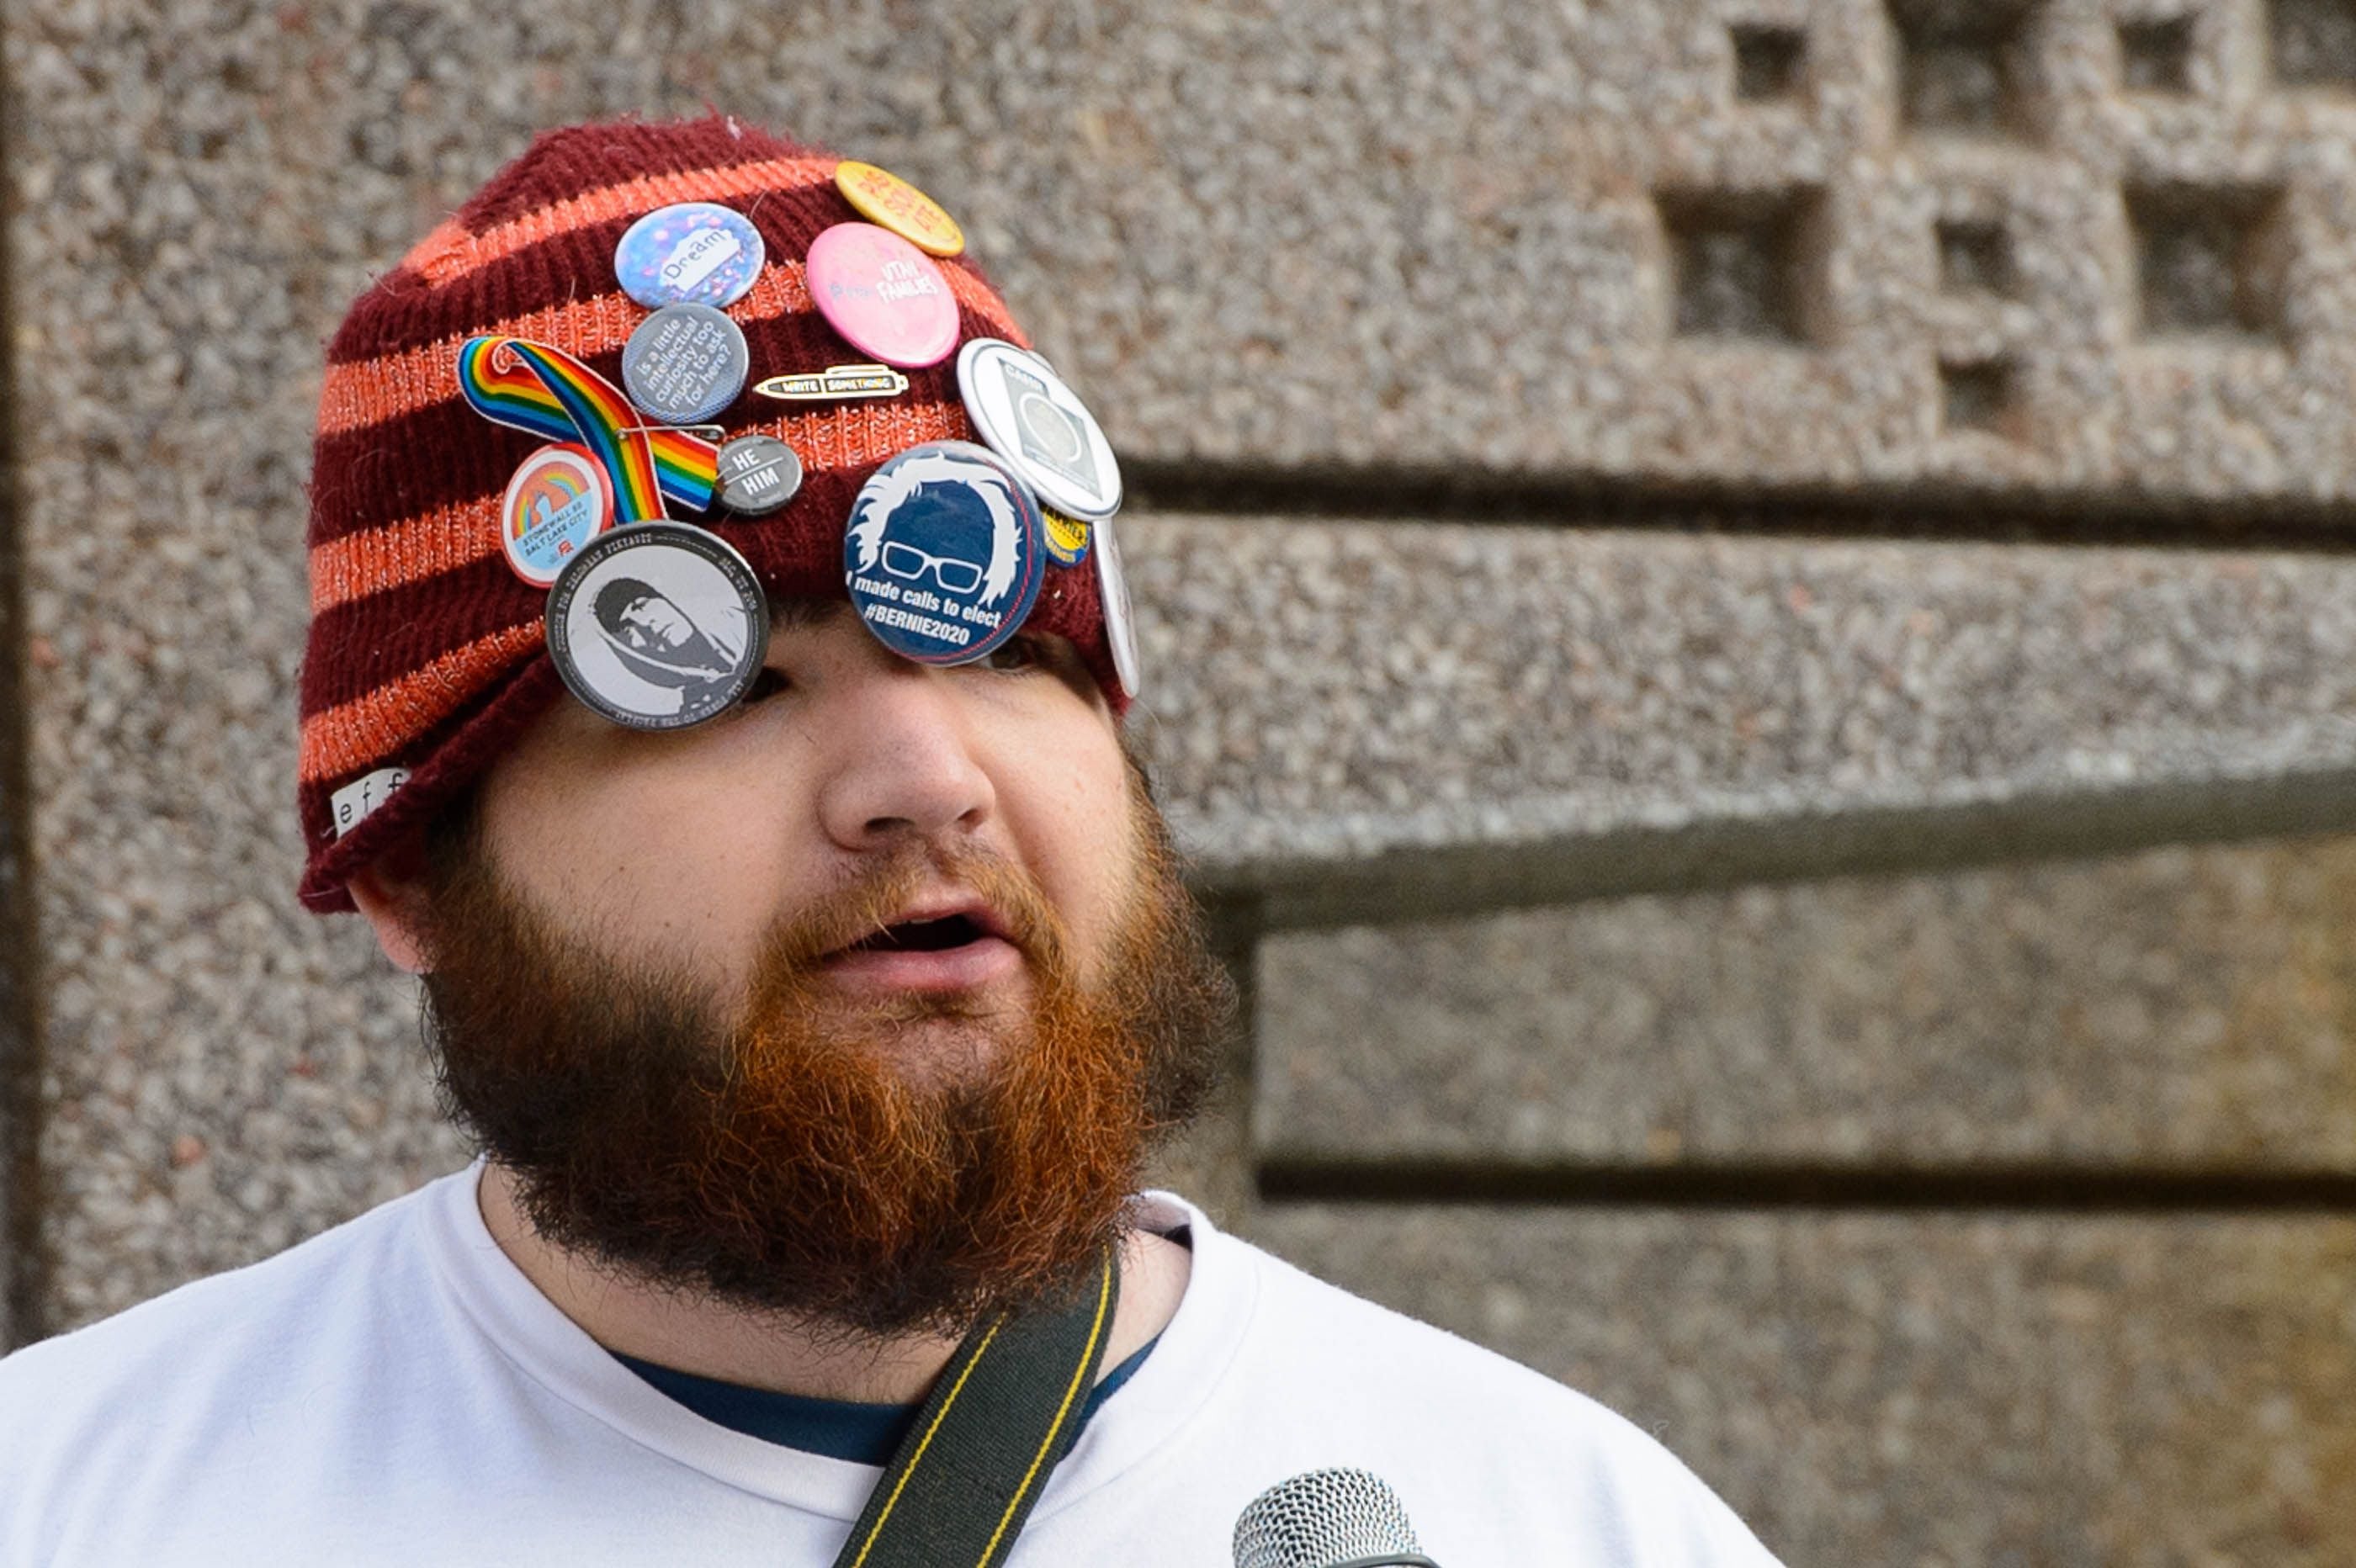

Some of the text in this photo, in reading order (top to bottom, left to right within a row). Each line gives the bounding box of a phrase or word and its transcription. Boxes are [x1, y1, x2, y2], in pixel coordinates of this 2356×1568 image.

[664, 230, 728, 279] Dream
[876, 275, 938, 303] FAMILIES
[643, 315, 699, 391] intellectual
[652, 319, 681, 351] little
[649, 352, 660, 363] a
[656, 321, 714, 402] curiosity too
[669, 329, 726, 410] much to ask
[685, 343, 731, 407] for here?
[781, 376, 891, 394] WRITE SOMETHING
[731, 448, 761, 471] HE
[740, 467, 780, 495] HIM
[523, 510, 571, 547] STONEWALL
[525, 537, 547, 557] SALT
[546, 522, 567, 543] LAKE
[569, 508, 588, 527] CITY
[844, 570, 1001, 629] I made calls to elect
[864, 602, 971, 646] #BERNIE2020
